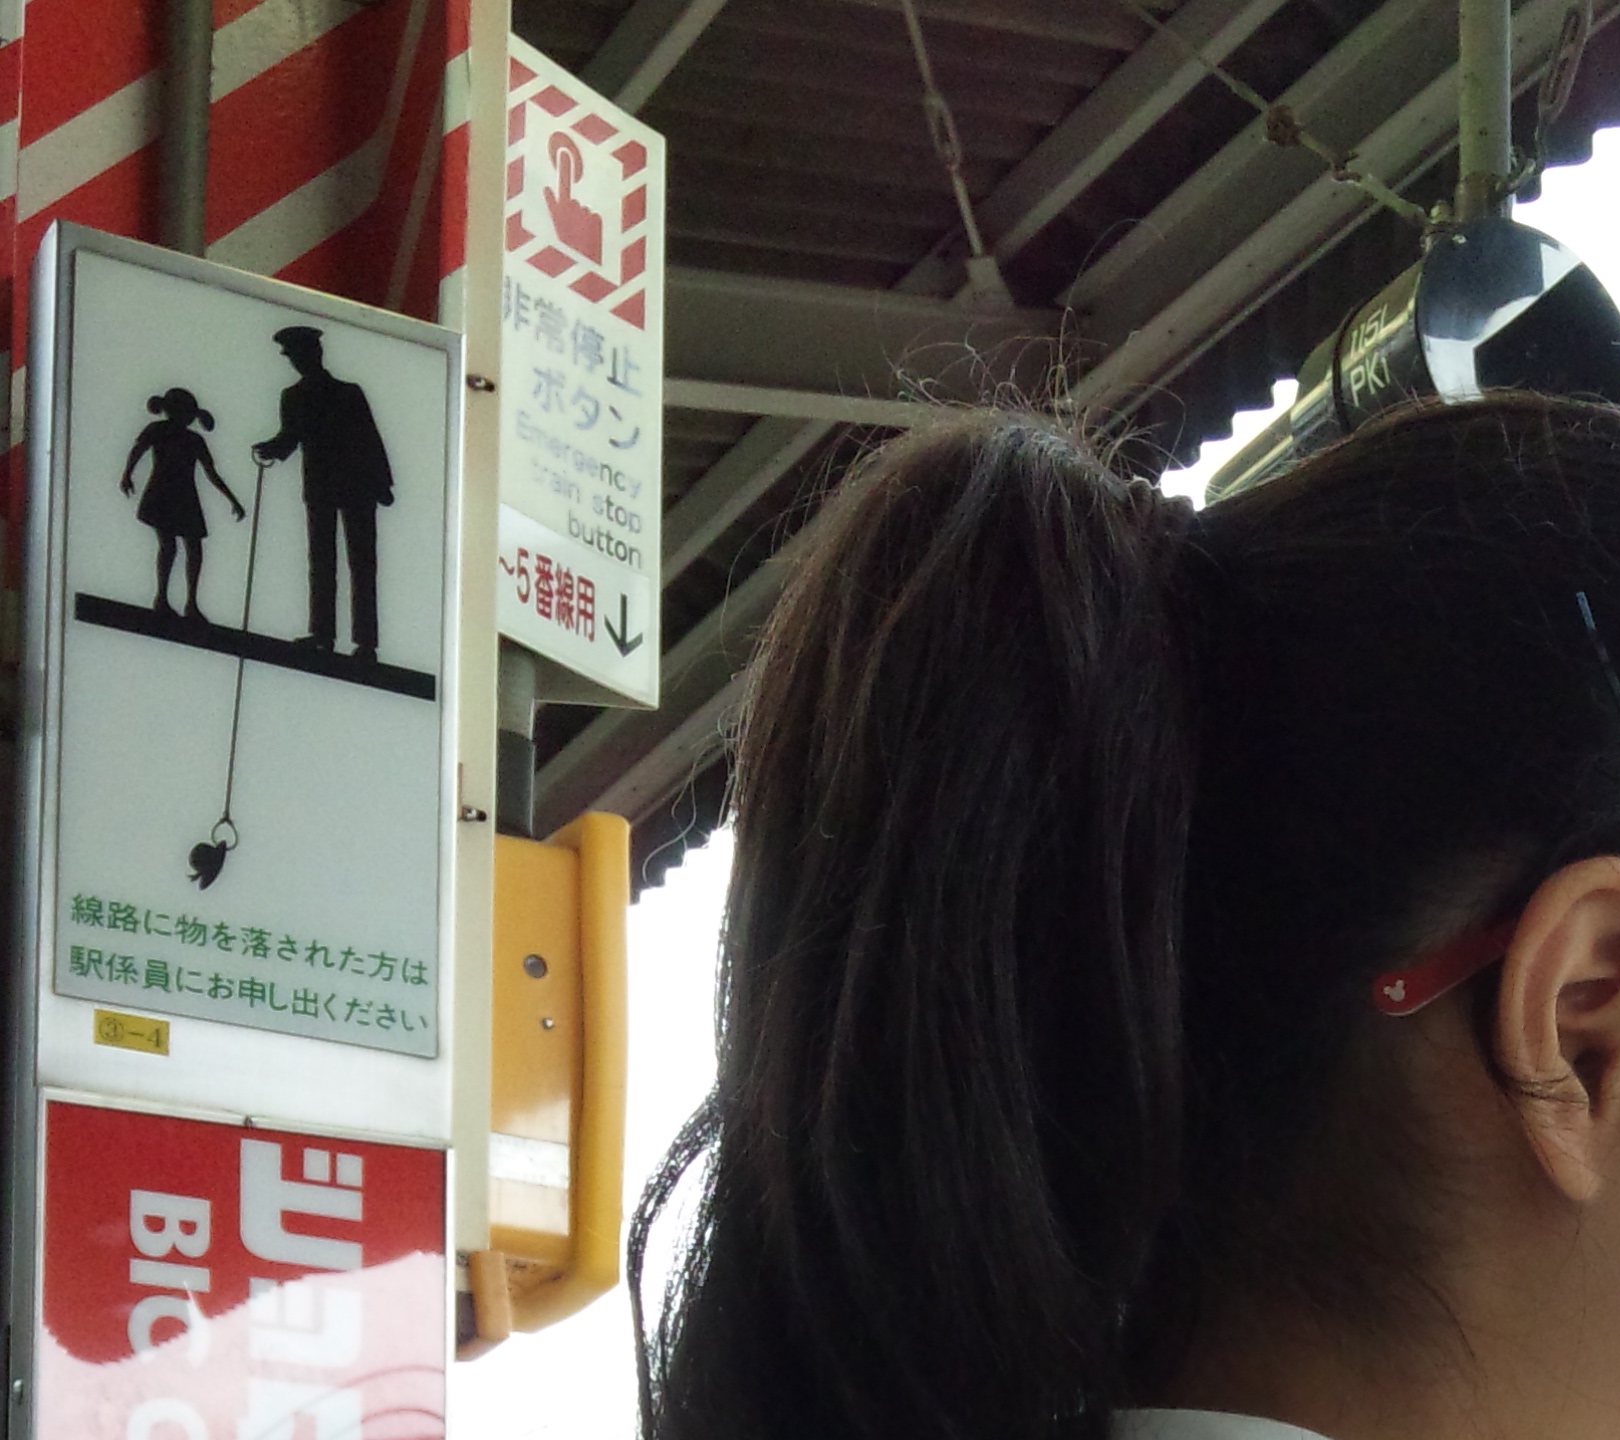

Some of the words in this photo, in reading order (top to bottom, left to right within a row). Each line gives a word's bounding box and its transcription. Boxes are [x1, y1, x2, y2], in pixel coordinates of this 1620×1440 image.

[532, 366, 641, 449] ボタン
[567, 509, 642, 569] button
[592, 493, 642, 534] stop
[71, 893, 429, 987] 線路に物を落された方は
[69, 945, 428, 1032] 駅係員にお申し出ください
[127, 1188, 211, 1369] BIC
